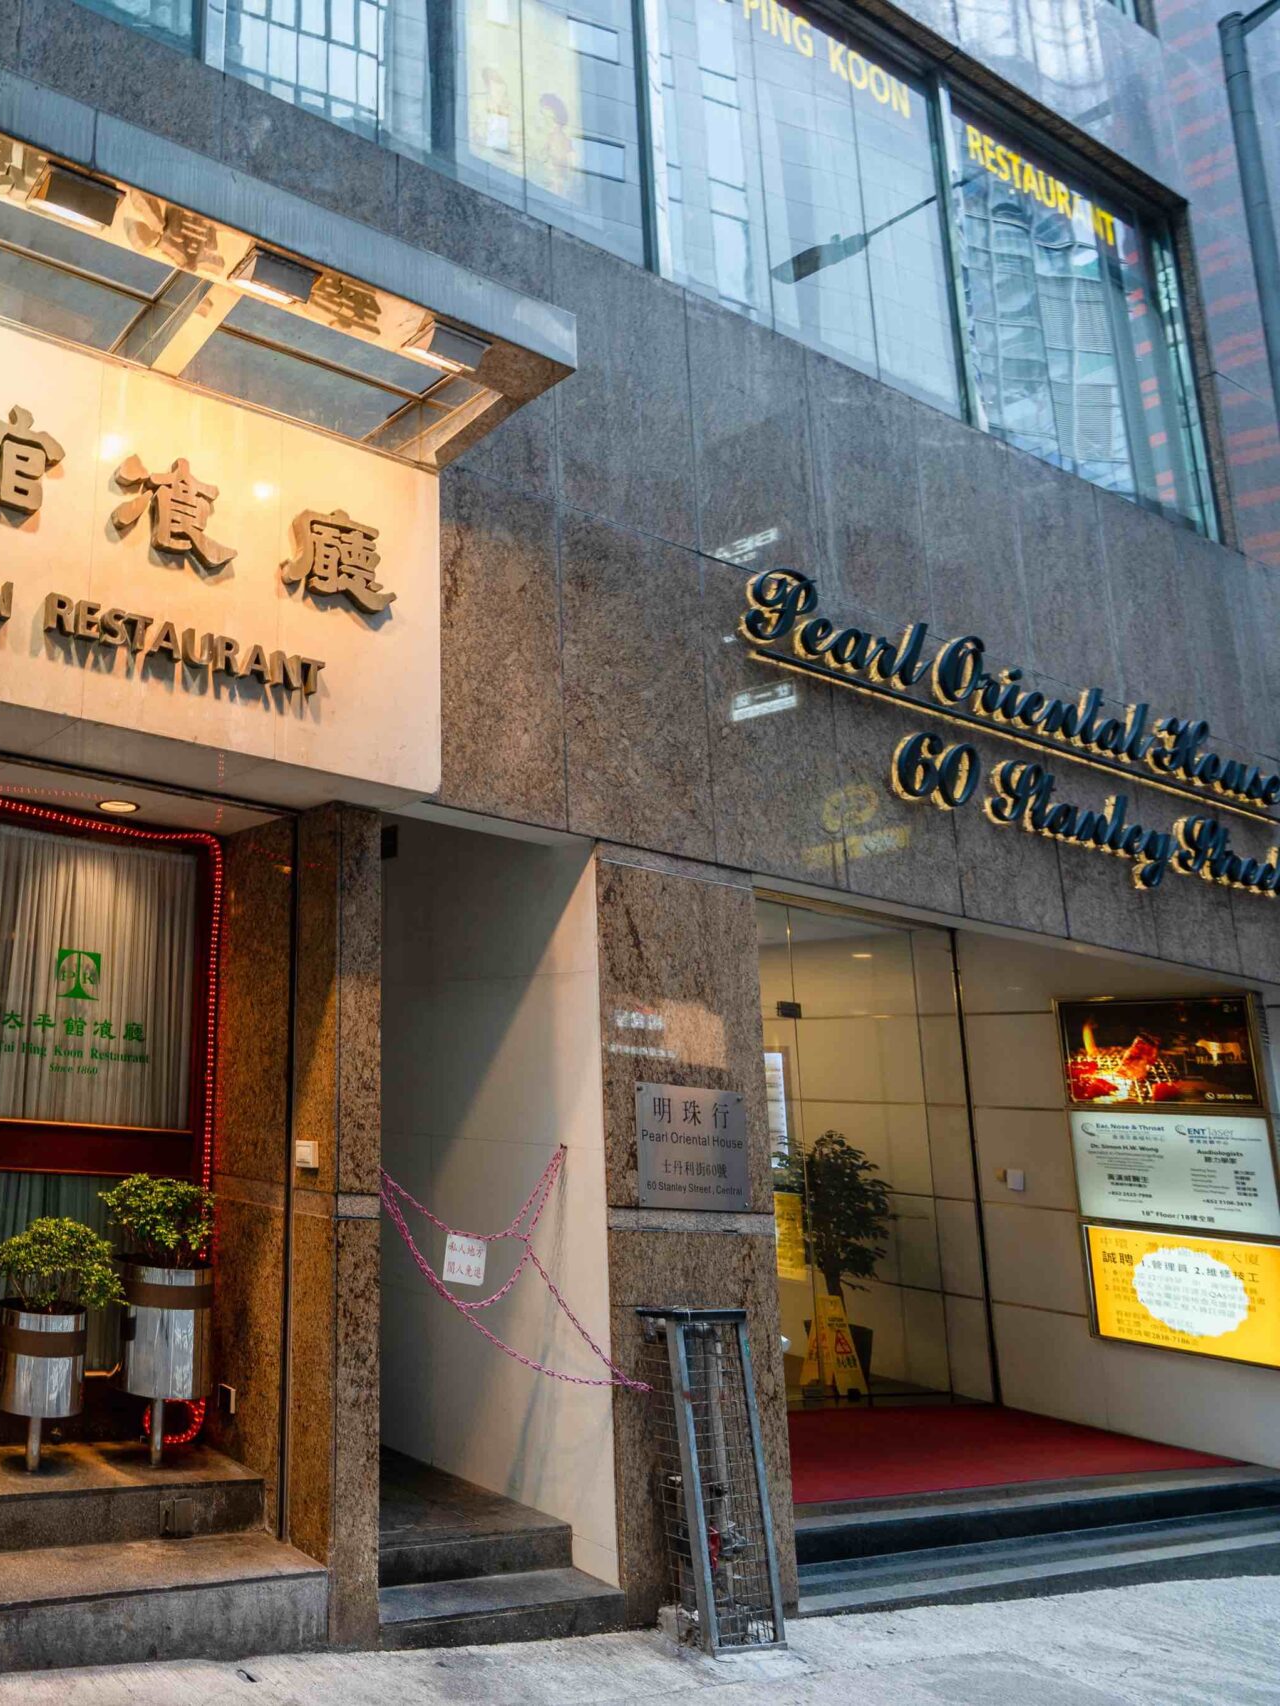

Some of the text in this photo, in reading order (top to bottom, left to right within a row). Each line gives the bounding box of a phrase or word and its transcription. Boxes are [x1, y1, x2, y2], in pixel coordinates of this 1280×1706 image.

[827, 35, 911, 119] KOON
[43, 591, 326, 696] RESTAURANT
[740, 568, 1280, 808] Pearl Oriental House
[892, 731, 980, 810] 60
[985, 760, 1178, 889] Stanley
[21, 1042, 47, 1058] Ping
[54, 1045, 83, 1058] Koon
[90, 1048, 150, 1064] Restaurant
[49, 1063, 73, 1073] Since
[652, 1096, 730, 1129] 明珠行
[641, 1129, 744, 1149] Pearl Oriental House
[1197, 1149, 1244, 1157] Audiologists
[663, 1159, 728, 1178] 士丹利街60號
[646, 1182, 657, 1190] 60
[658, 1182, 687, 1193] Stanley
[716, 1186, 743, 1196] Central
[1155, 1211, 1176, 1219] Floor
[448, 1241, 484, 1258] 私人地方
[1102, 1251, 1134, 1266] 誠聘
